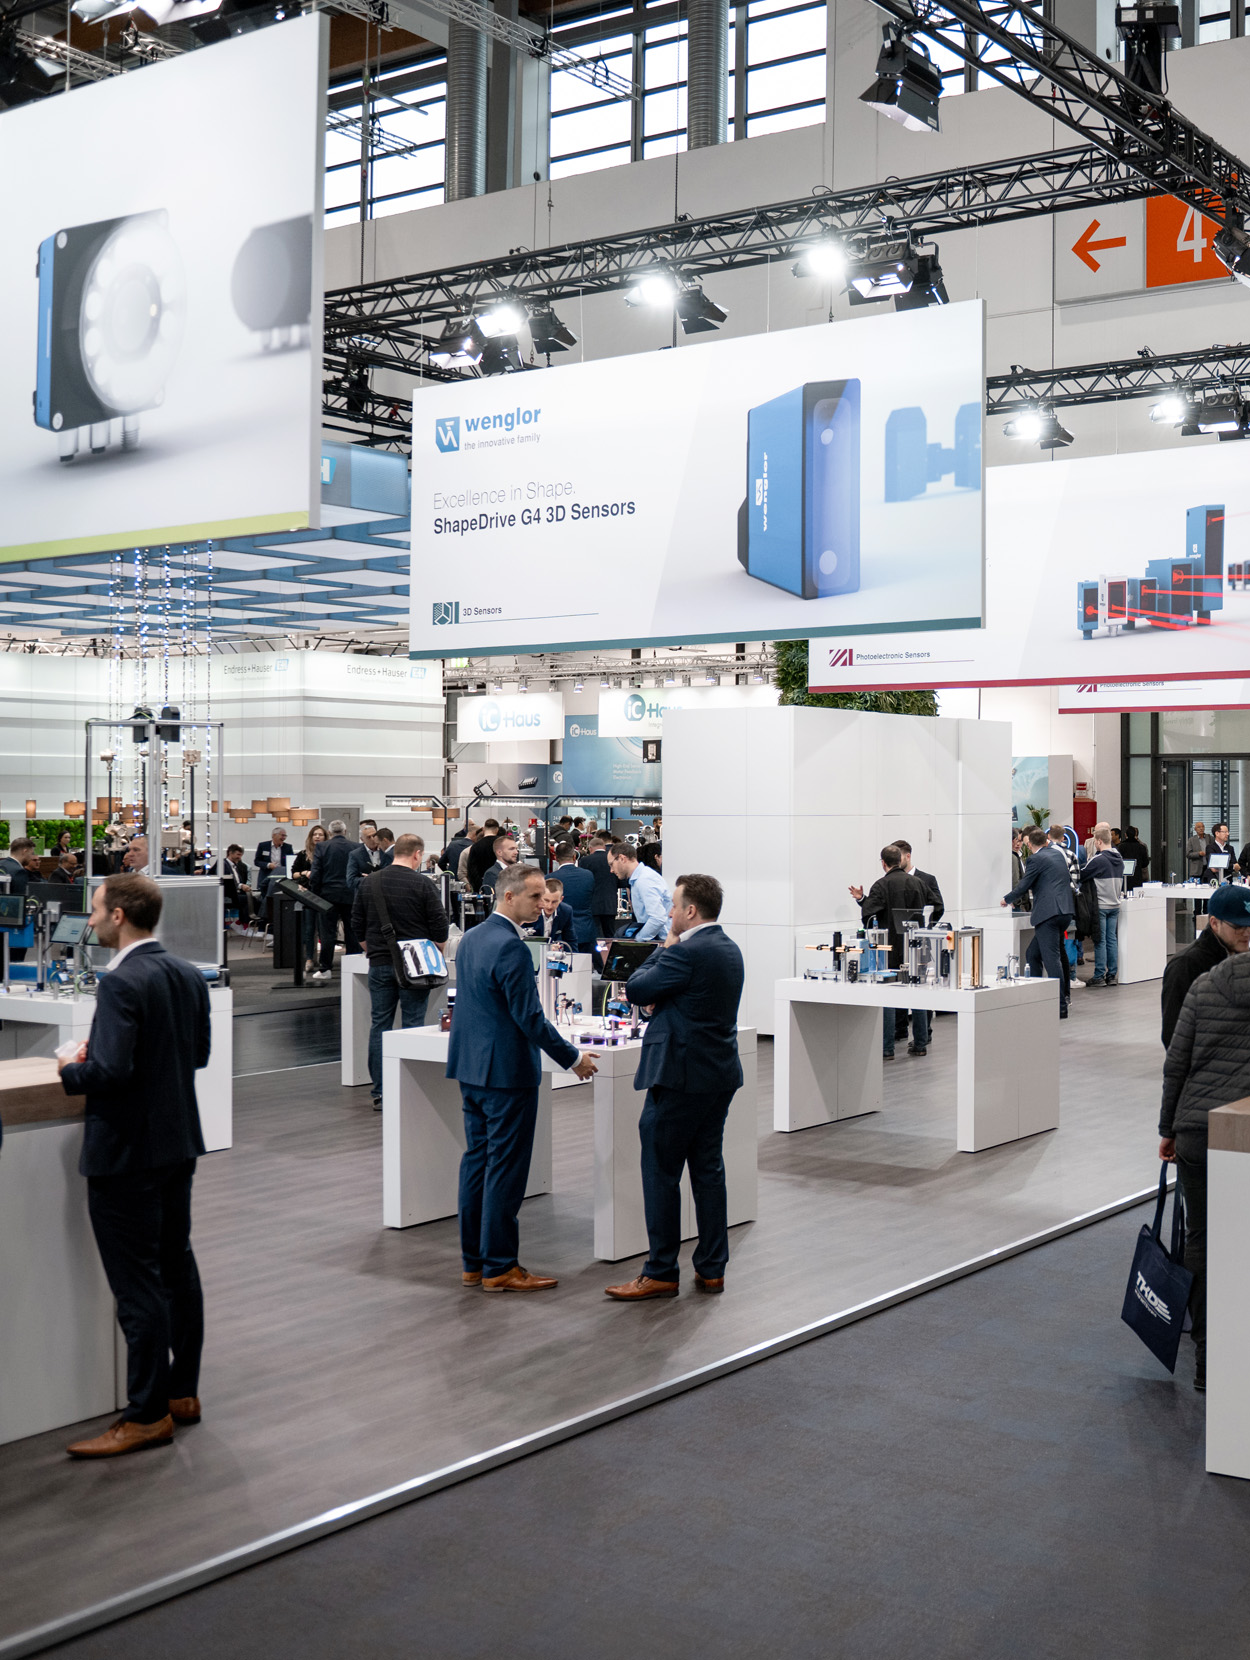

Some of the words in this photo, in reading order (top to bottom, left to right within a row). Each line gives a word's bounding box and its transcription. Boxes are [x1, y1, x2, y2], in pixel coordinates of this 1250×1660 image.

[1176, 204, 1207, 263] 4
[465, 407, 541, 432] wenglor
[464, 442, 476, 450] the
[477, 436, 515, 449] innovative
[517, 433, 541, 445] family
[433, 489, 506, 510] Excellence
[510, 484, 522, 501] in
[526, 482, 576, 500] Shape.
[434, 512, 516, 536] ShapeDrive
[521, 508, 541, 525] G4
[546, 505, 566, 523] 3D
[571, 501, 636, 520] Sensors
[463, 608, 472, 616] 3D
[474, 607, 502, 615] Sensors
